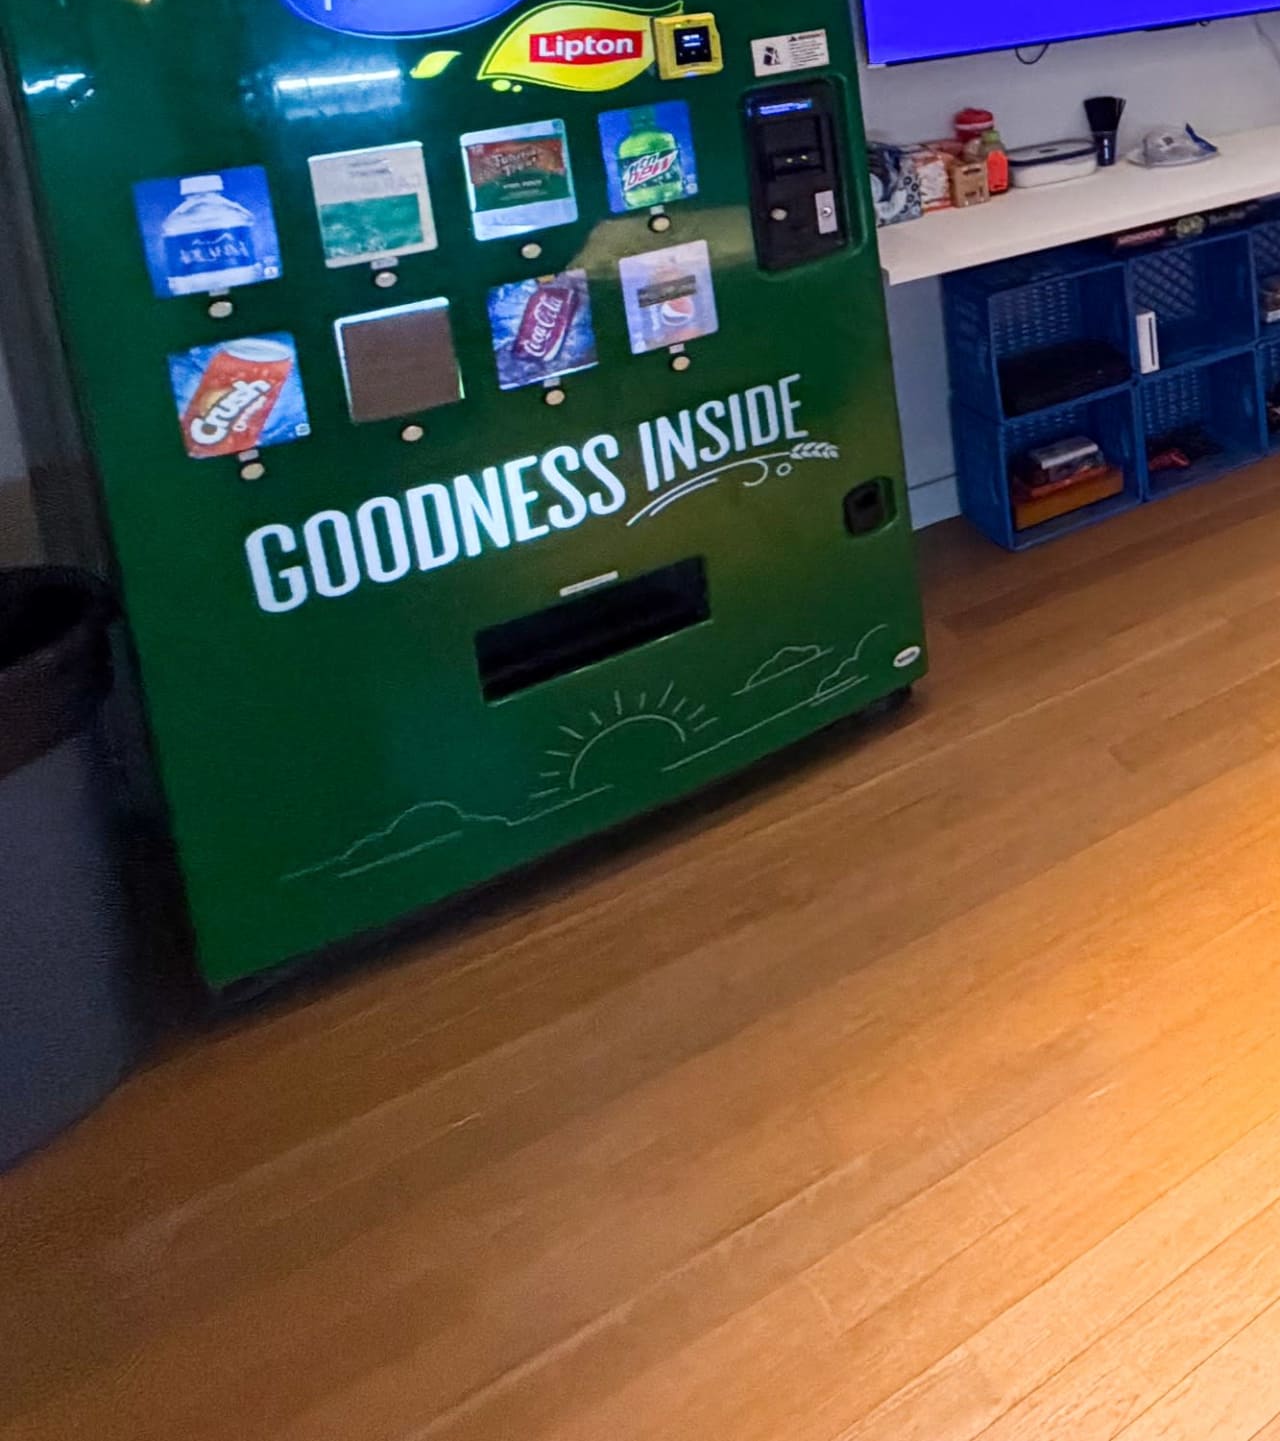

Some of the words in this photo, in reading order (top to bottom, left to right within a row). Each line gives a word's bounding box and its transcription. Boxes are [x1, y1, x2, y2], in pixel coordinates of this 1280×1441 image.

[537, 34, 635, 61] Lipton
[190, 379, 271, 445] Crush
[244, 433, 627, 614] GOODNESS
[638, 373, 809, 492] INSIDE
